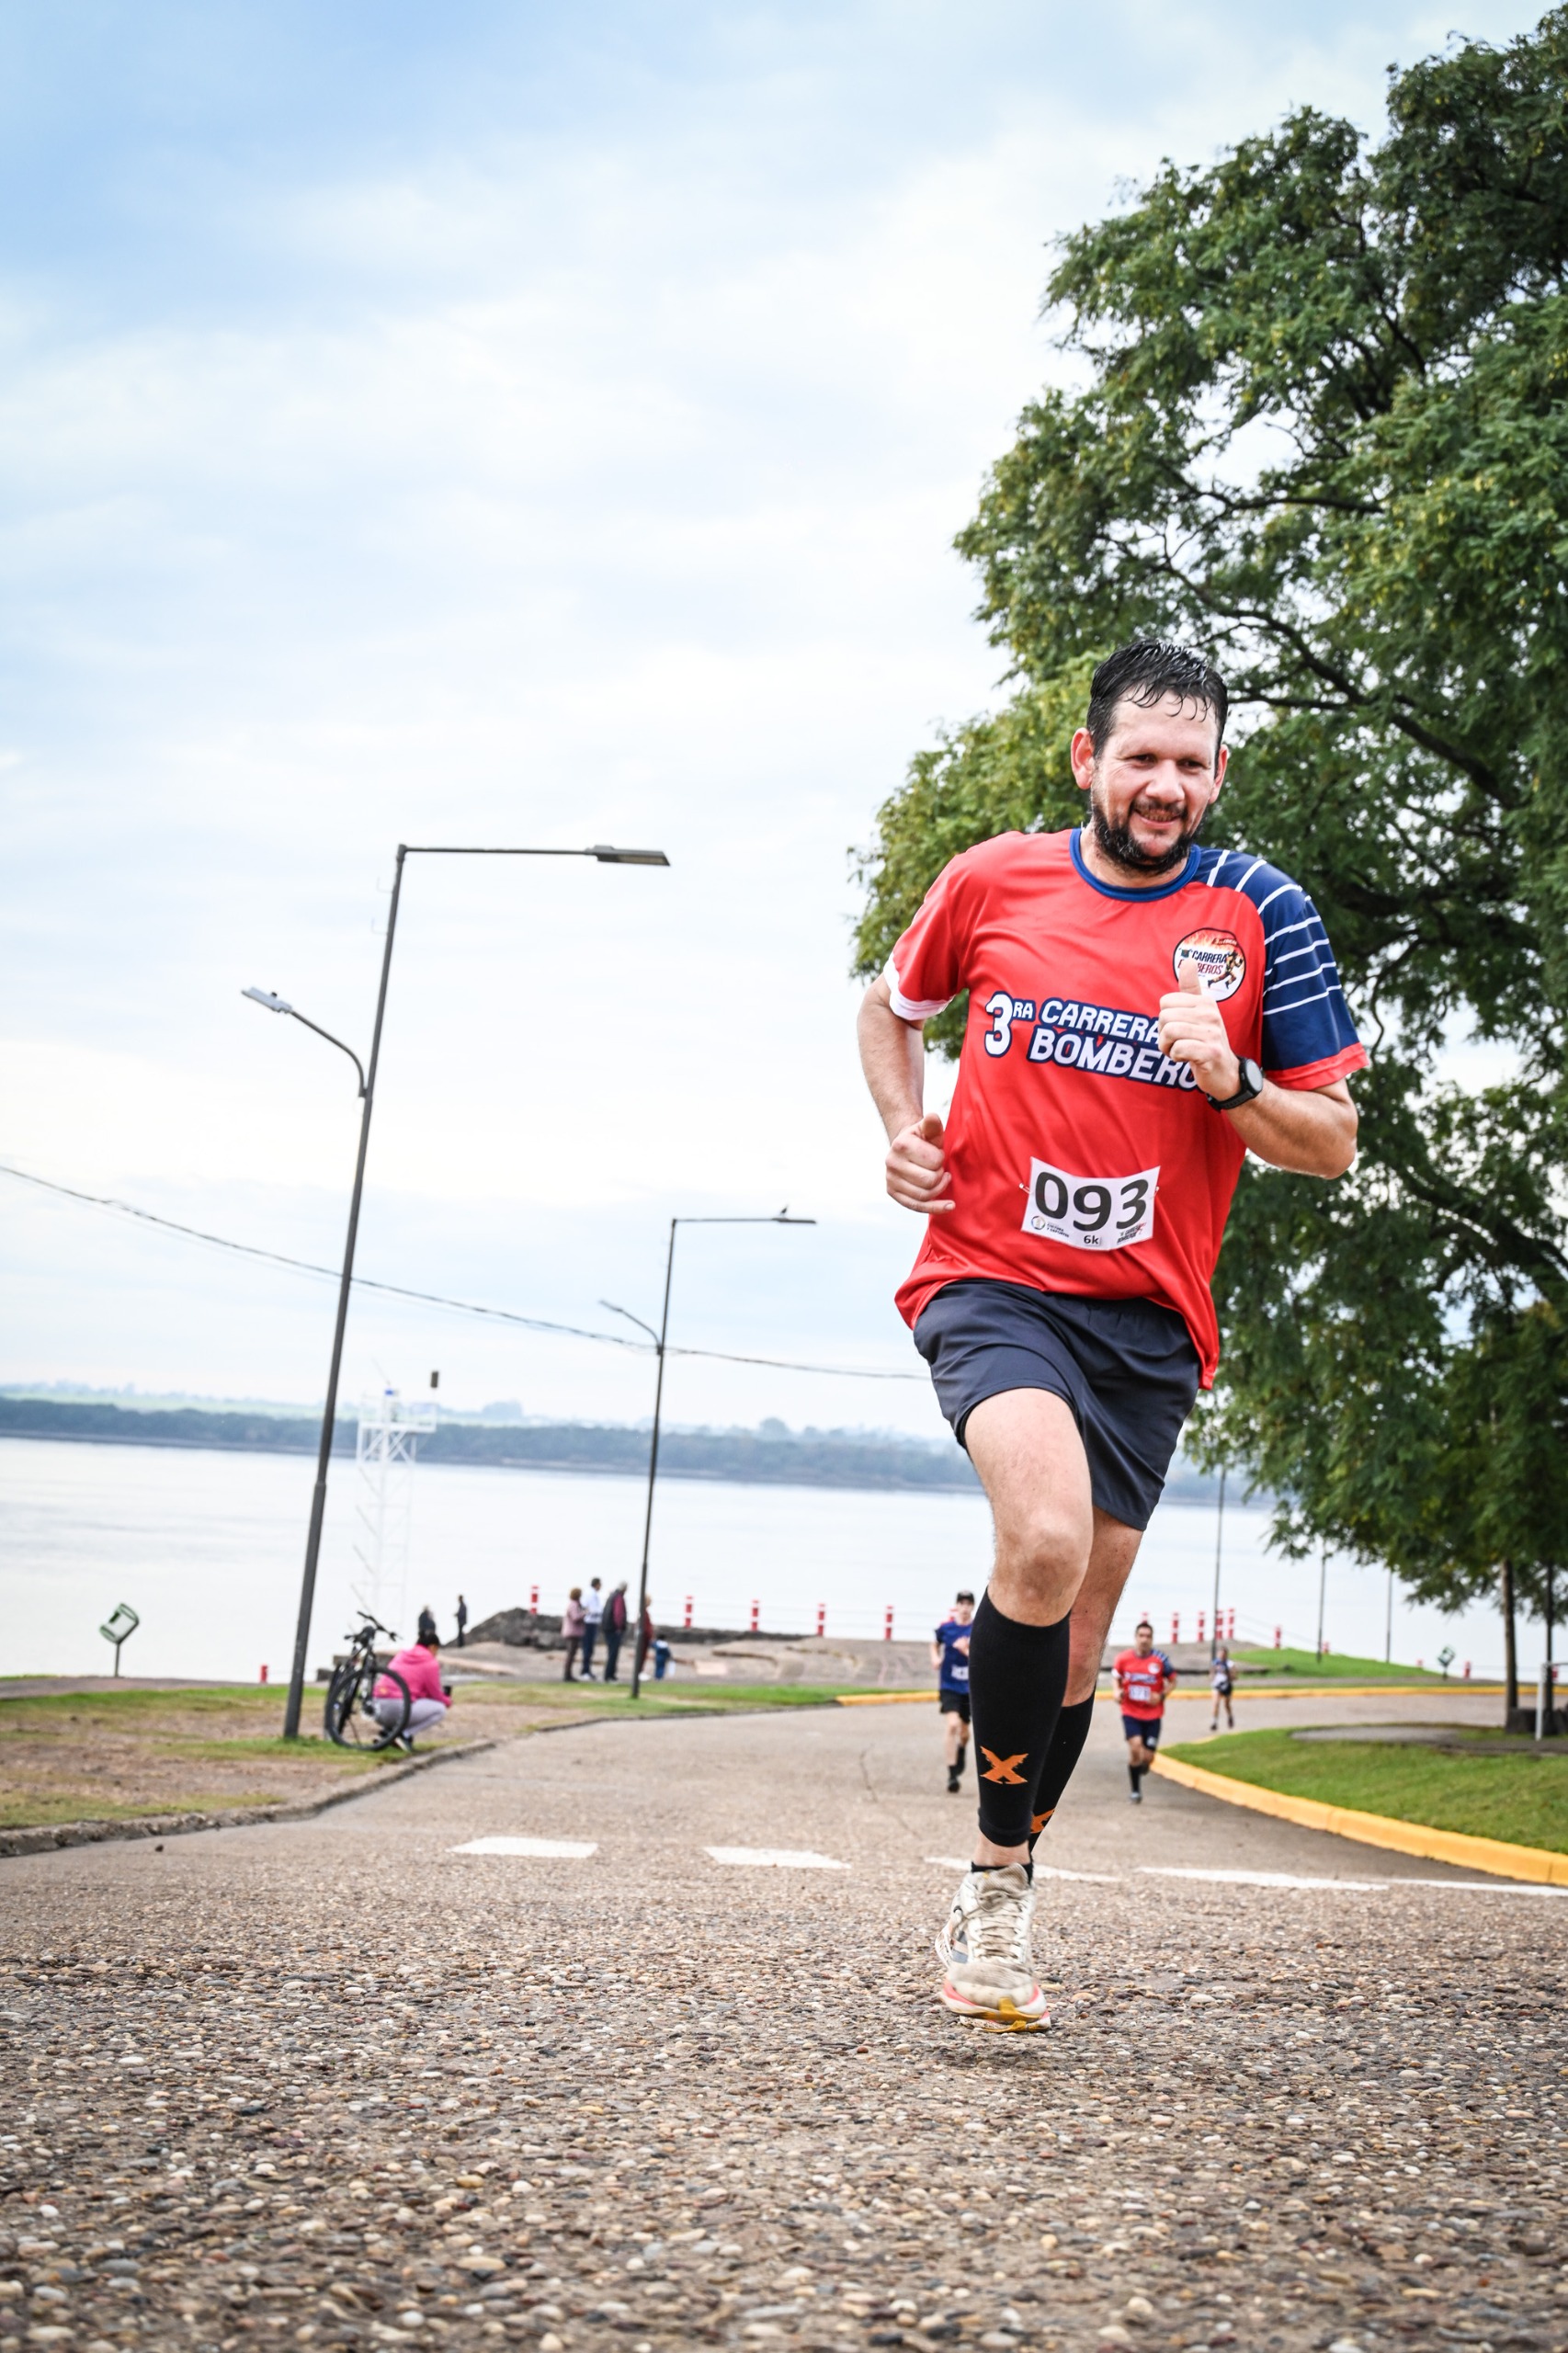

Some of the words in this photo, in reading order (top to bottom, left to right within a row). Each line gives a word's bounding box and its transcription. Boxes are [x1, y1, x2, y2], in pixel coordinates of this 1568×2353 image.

[1192, 949, 1227, 964] CARRERA
[1029, 1028, 1199, 1089] BOMBERO
[1035, 1171, 1149, 1232] 093
[1084, 1234, 1099, 1245] 6k
